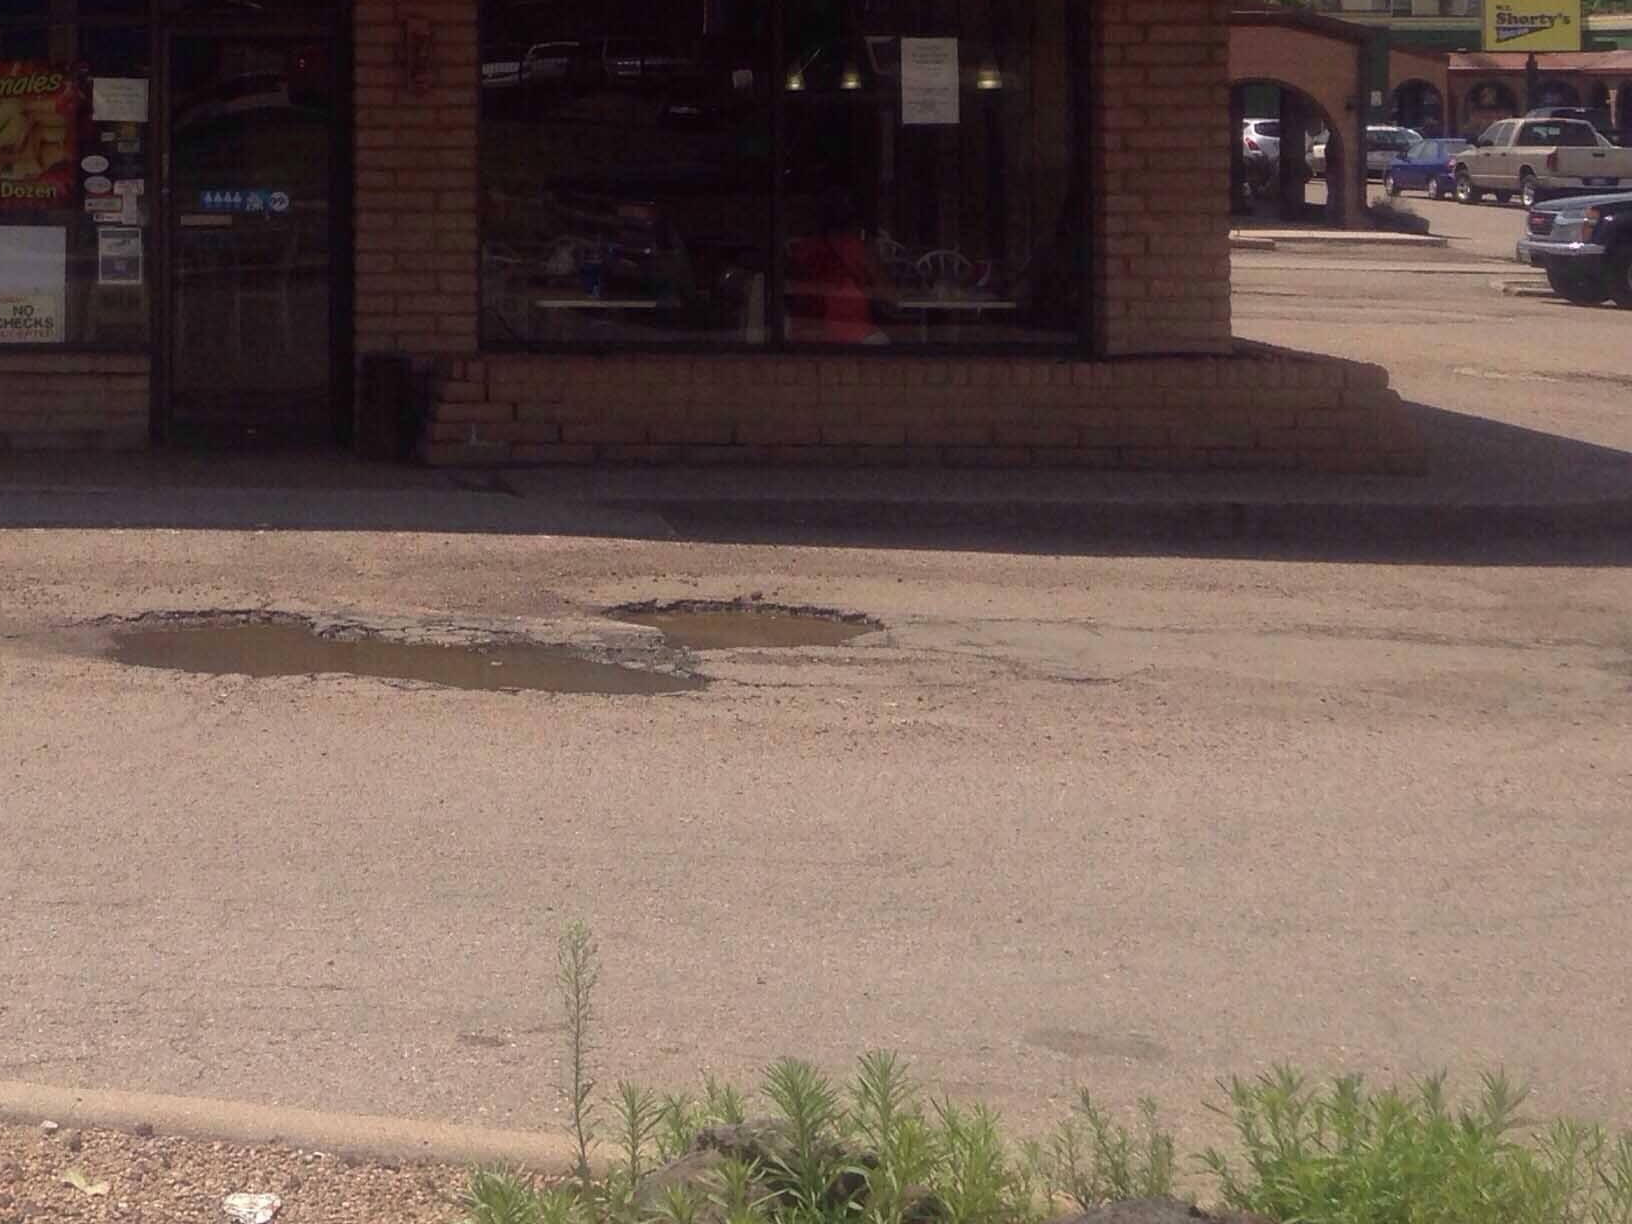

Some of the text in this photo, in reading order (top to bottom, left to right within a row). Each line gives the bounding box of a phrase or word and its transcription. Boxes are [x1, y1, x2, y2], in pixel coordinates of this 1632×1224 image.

[1495, 11, 1571, 28] Shorty's
[0, 181, 57, 199] Dozen
[12, 305, 35, 316] NO
